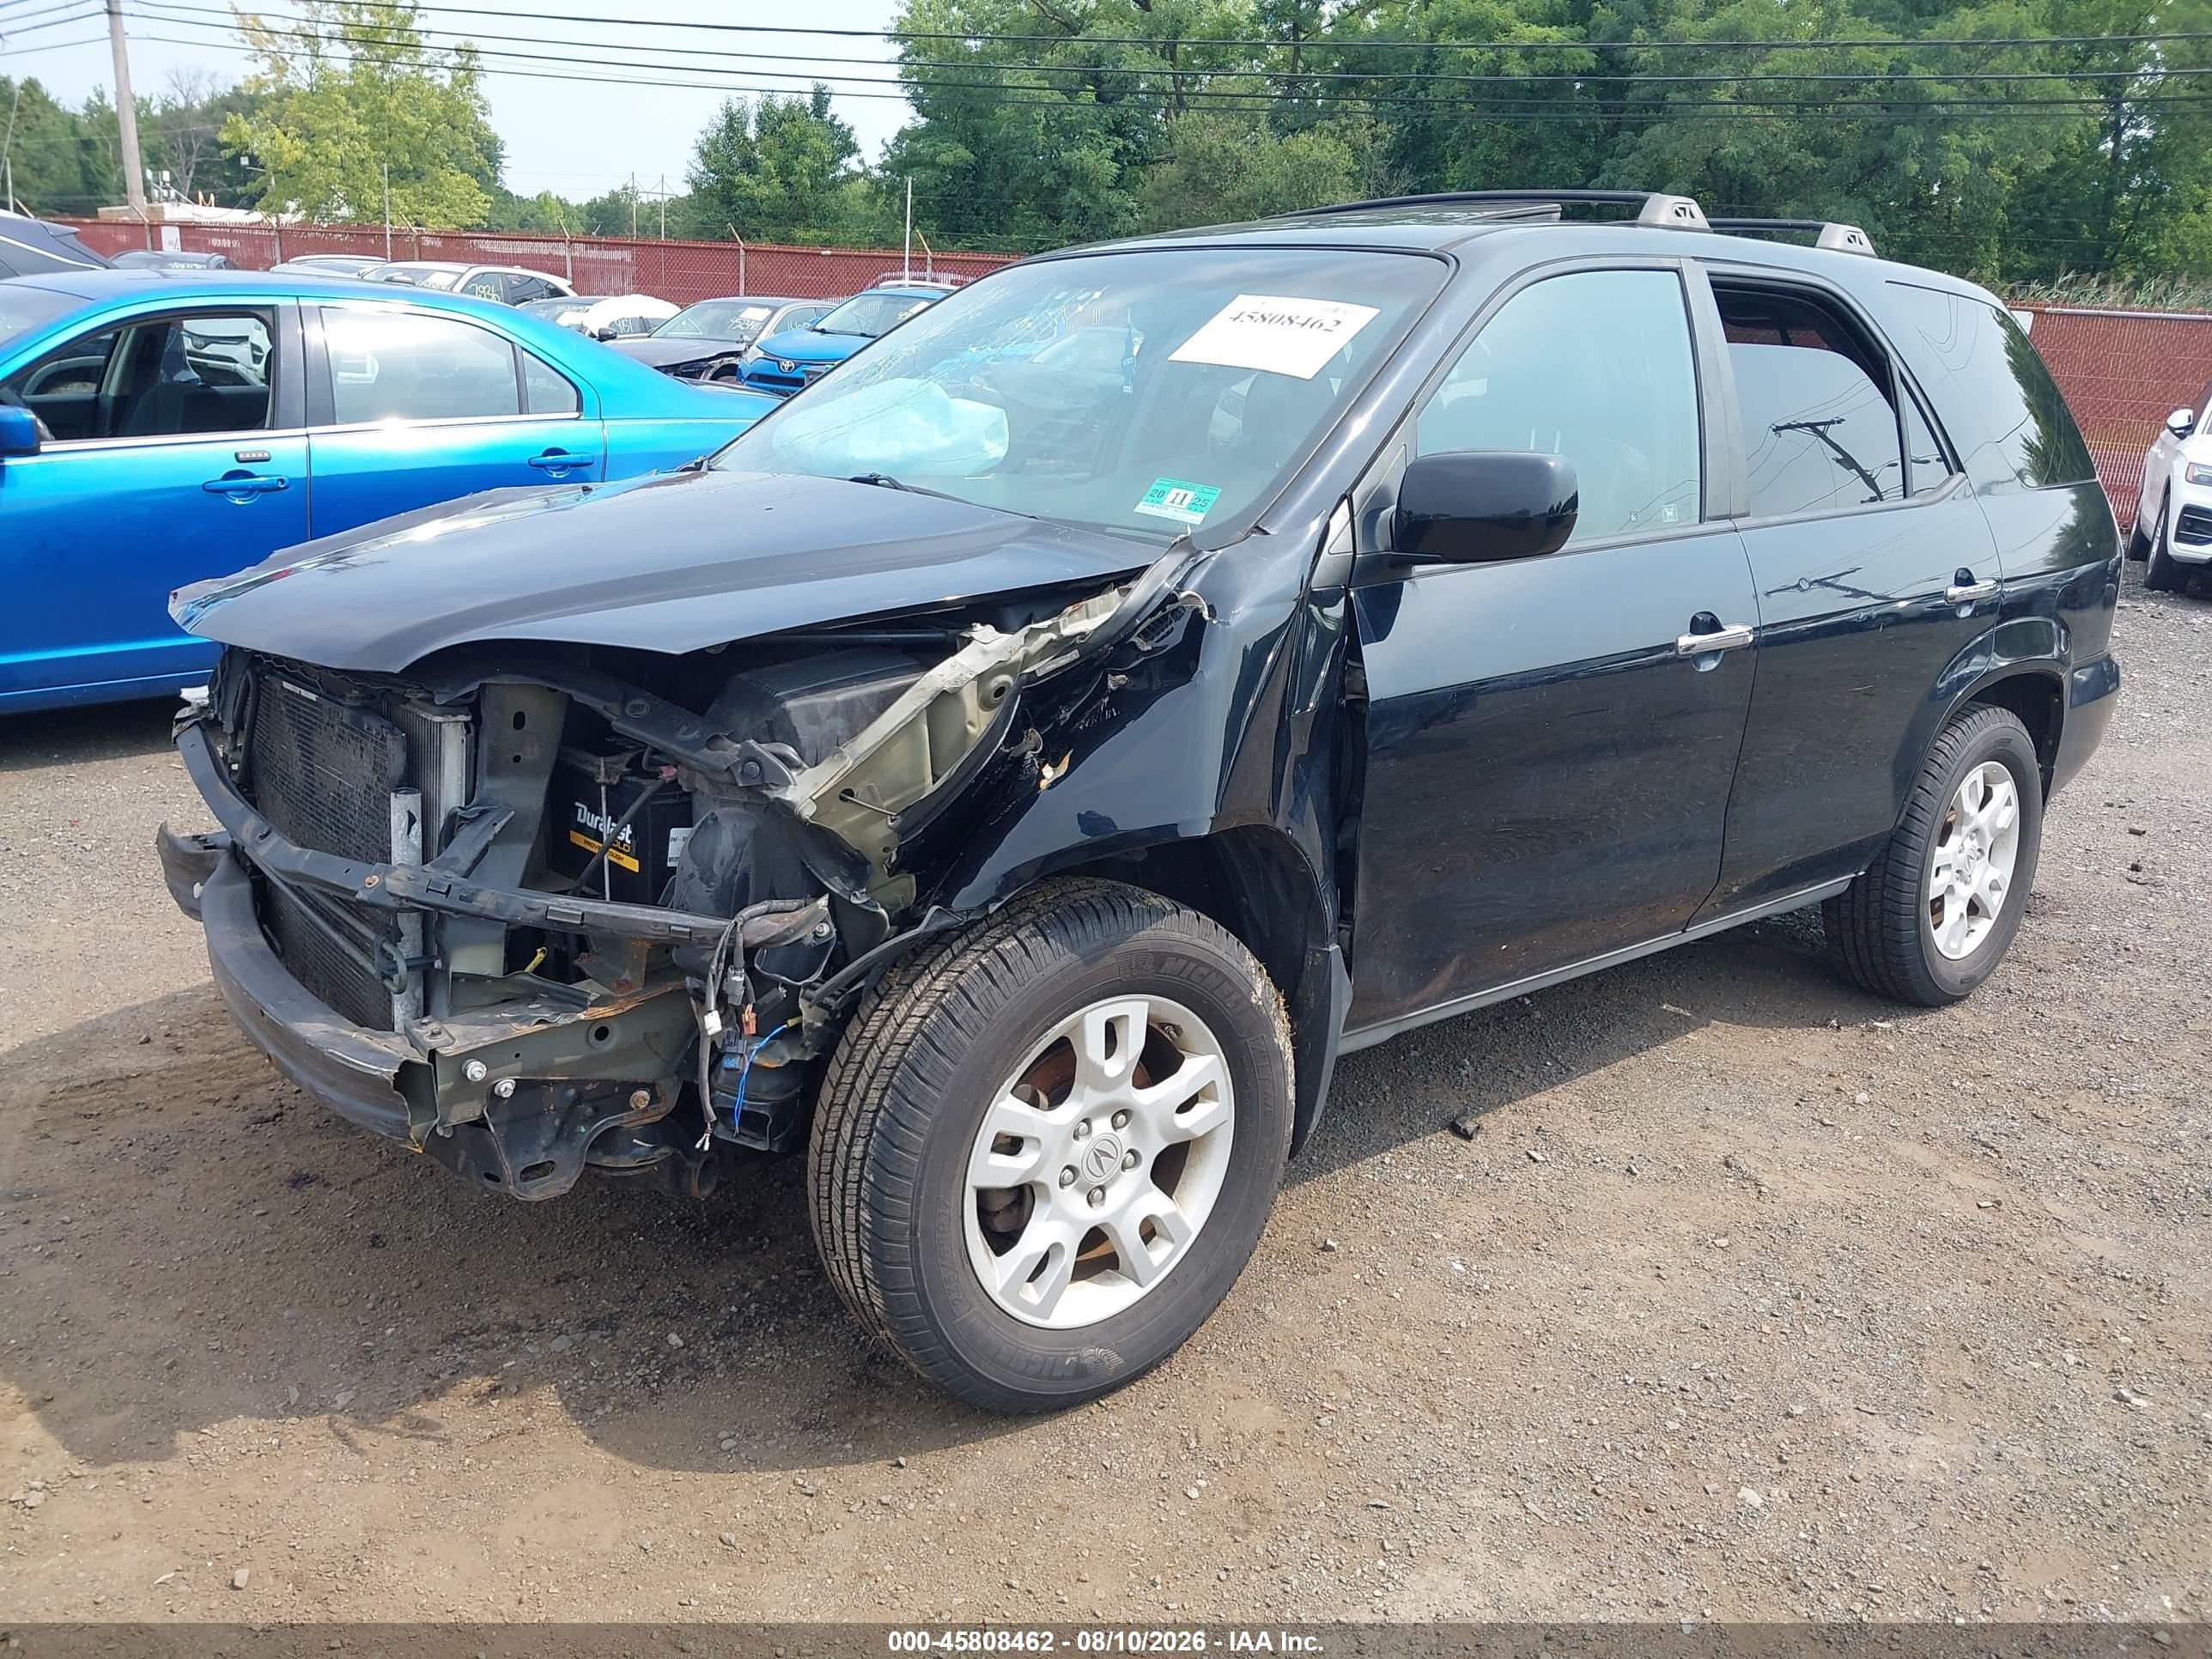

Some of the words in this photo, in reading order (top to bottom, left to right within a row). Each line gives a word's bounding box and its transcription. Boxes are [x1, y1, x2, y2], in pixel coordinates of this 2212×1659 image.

[1229, 310, 1342, 332] 45808462
[1149, 489, 1166, 499] 20
[1169, 491, 1189, 506] 11
[1191, 497, 1210, 507] 25
[612, 839, 631, 853] OLD
[608, 850, 624, 862] OUGH
[1159, 955, 1256, 1033] MICHELIN
